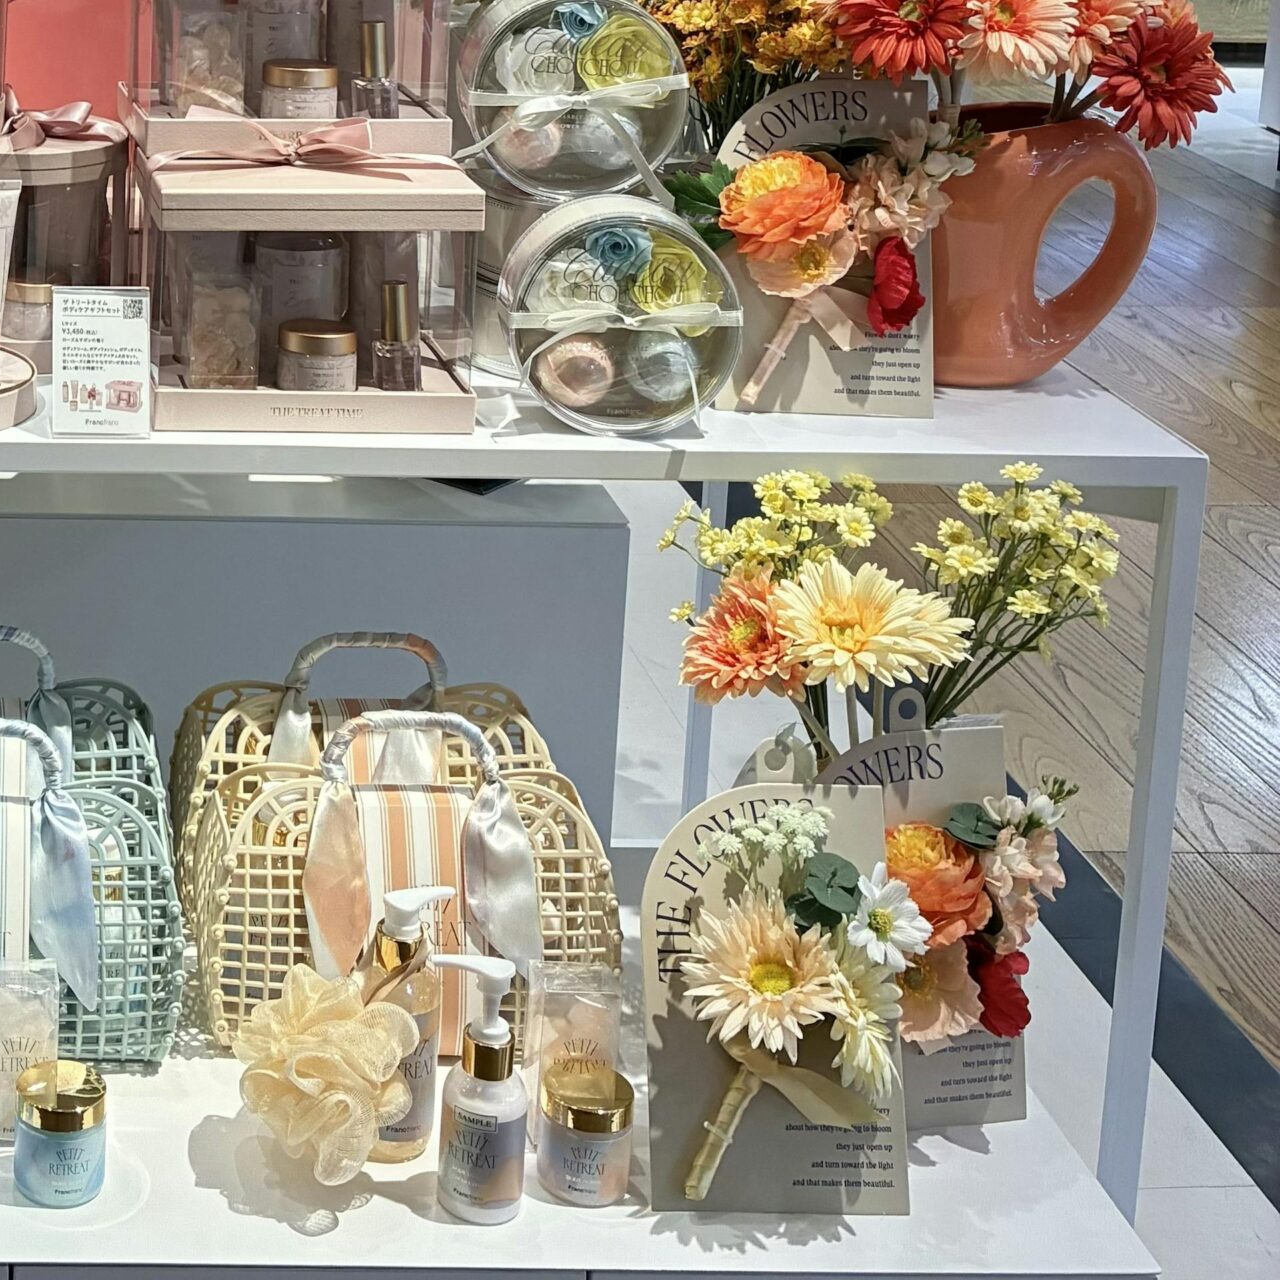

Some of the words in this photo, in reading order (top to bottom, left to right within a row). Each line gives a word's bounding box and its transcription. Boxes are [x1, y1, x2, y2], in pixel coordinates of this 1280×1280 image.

[733, 90, 868, 161] FLOWERS
[1, 1036, 40, 1055] PETIT
[458, 1112, 494, 1128] SAMPLE
[56, 1147, 86, 1162] PETIT
[448, 1141, 497, 1169] RETREAT
[48, 1160, 90, 1176] RETREAT
